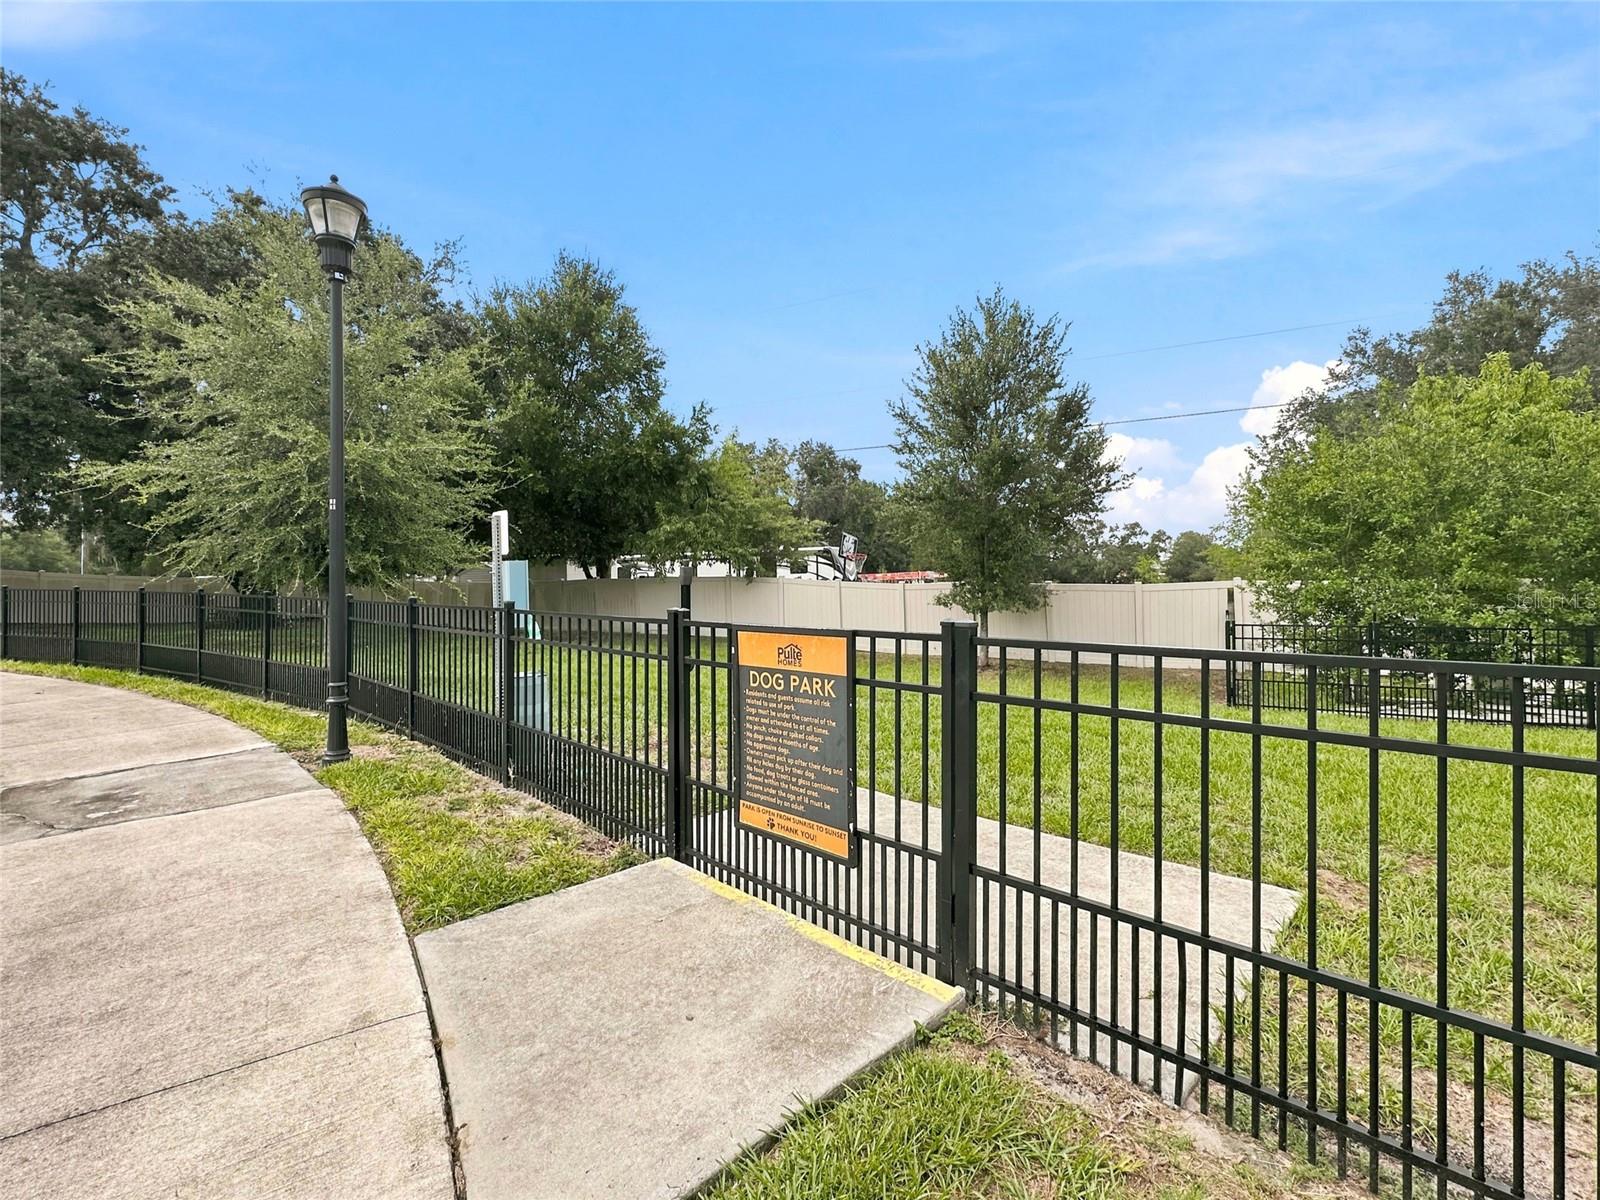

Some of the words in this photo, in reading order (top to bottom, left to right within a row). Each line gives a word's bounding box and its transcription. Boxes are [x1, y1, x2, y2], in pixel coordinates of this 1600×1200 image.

[778, 646, 802, 660] Pulte
[749, 670, 785, 690] DOG
[790, 675, 837, 698] PARK
[746, 689, 766, 697] Residents
[777, 694, 792, 703] guests
[746, 705, 756, 714] Dogs
[800, 715, 818, 724] control
[770, 718, 791, 727] attended
[813, 726, 829, 735] times.
[789, 730, 804, 741] spiked
[805, 734, 823, 743] collars.
[753, 732, 763, 741] dogs
[783, 738, 801, 748] months
[753, 740, 776, 752] aggressive
[746, 747, 762, 756] Owners
[764, 751, 775, 759] must
[776, 754, 786, 764] pick
[794, 758, 807, 767] after
[808, 762, 820, 770] their
[762, 759, 773, 767] holes
[792, 767, 803, 775] their
[804, 770, 816, 780] dog.
[746, 772, 763, 782] allowed
[764, 777, 779, 786] within
[789, 784, 805, 794] fenced
[806, 790, 820, 798] area.
[776, 771, 790, 781] treats
[798, 777, 809, 787] glass
[811, 781, 838, 794] containers
[746, 780, 762, 791] Anyone
[763, 785, 776, 794] under
[809, 798, 822, 808] must
[746, 788, 775, 804] accompanied
[791, 802, 805, 812] adult.
[742, 803, 755, 811] PARK
[762, 808, 776, 817] OPEN
[776, 812, 792, 822] FROM
[792, 817, 815, 830] SUNRISE
[816, 824, 824, 832] TO
[824, 826, 847, 840] SUNSET
[776, 822, 798, 836] THANK
[800, 831, 817, 842] YOU!
